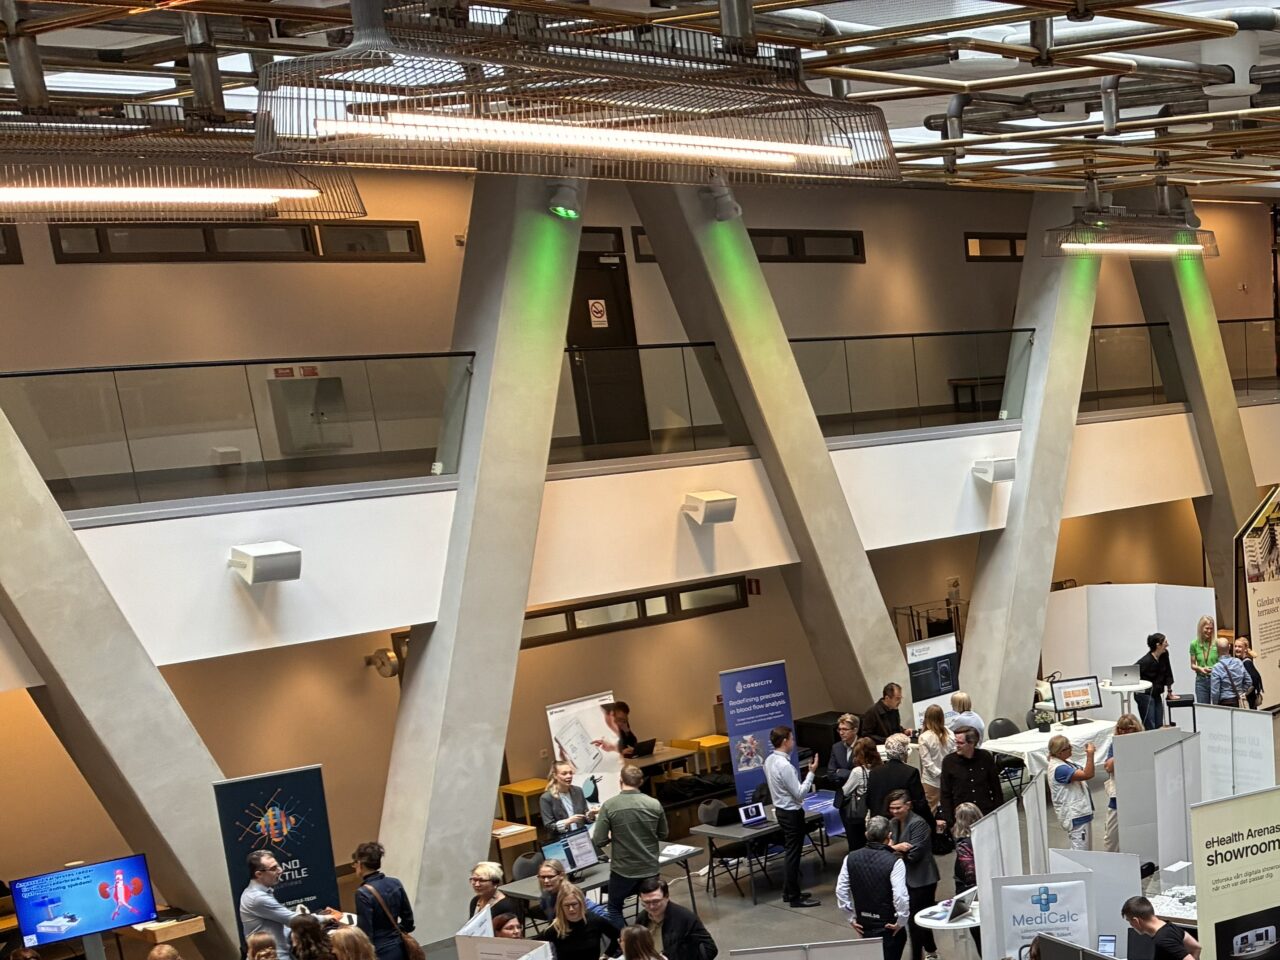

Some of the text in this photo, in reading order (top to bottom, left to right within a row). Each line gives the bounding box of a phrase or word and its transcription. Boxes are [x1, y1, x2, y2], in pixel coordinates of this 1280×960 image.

[728, 691, 784, 706] Redefining precision
[736, 706, 752, 714] blood
[1205, 824, 1280, 849] eHealth Arenas
[1206, 838, 1280, 867] showroom
[1233, 872, 1243, 880] vårt
[1244, 869, 1261, 879] digitala
[1248, 874, 1264, 883] passar
[1012, 911, 1079, 926] MediCalc
